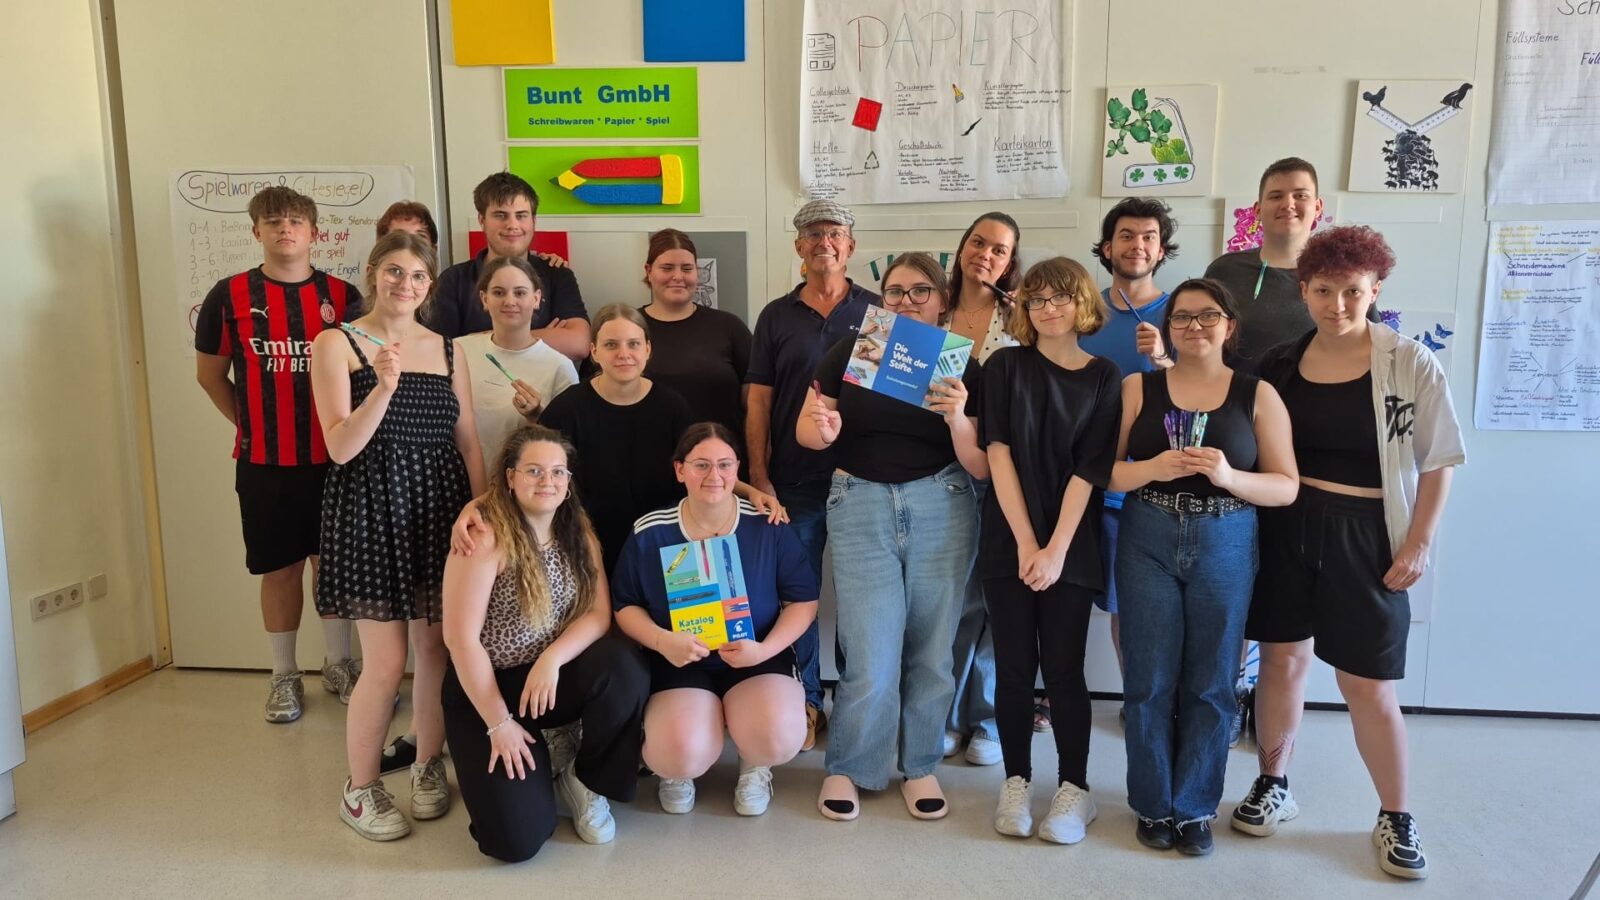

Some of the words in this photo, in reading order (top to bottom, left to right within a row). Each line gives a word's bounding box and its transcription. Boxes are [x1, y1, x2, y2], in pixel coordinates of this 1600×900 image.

[848, 10, 1039, 72] PAPIER
[1506, 31, 1559, 44] Füllsysteme
[527, 87, 582, 104] Bunt
[598, 84, 670, 103] GmbH
[528, 117, 594, 126] Schreibwaren
[604, 117, 635, 126] Papier
[646, 117, 670, 126] Spiel
[993, 133, 1053, 151] Karteikarten
[335, 228, 351, 246] gut
[337, 261, 361, 279] Engel
[894, 342, 909, 354] Die
[266, 357, 286, 372] FLY
[892, 351, 913, 365] Welt
[913, 358, 929, 369] der
[679, 616, 714, 627] Katalog
